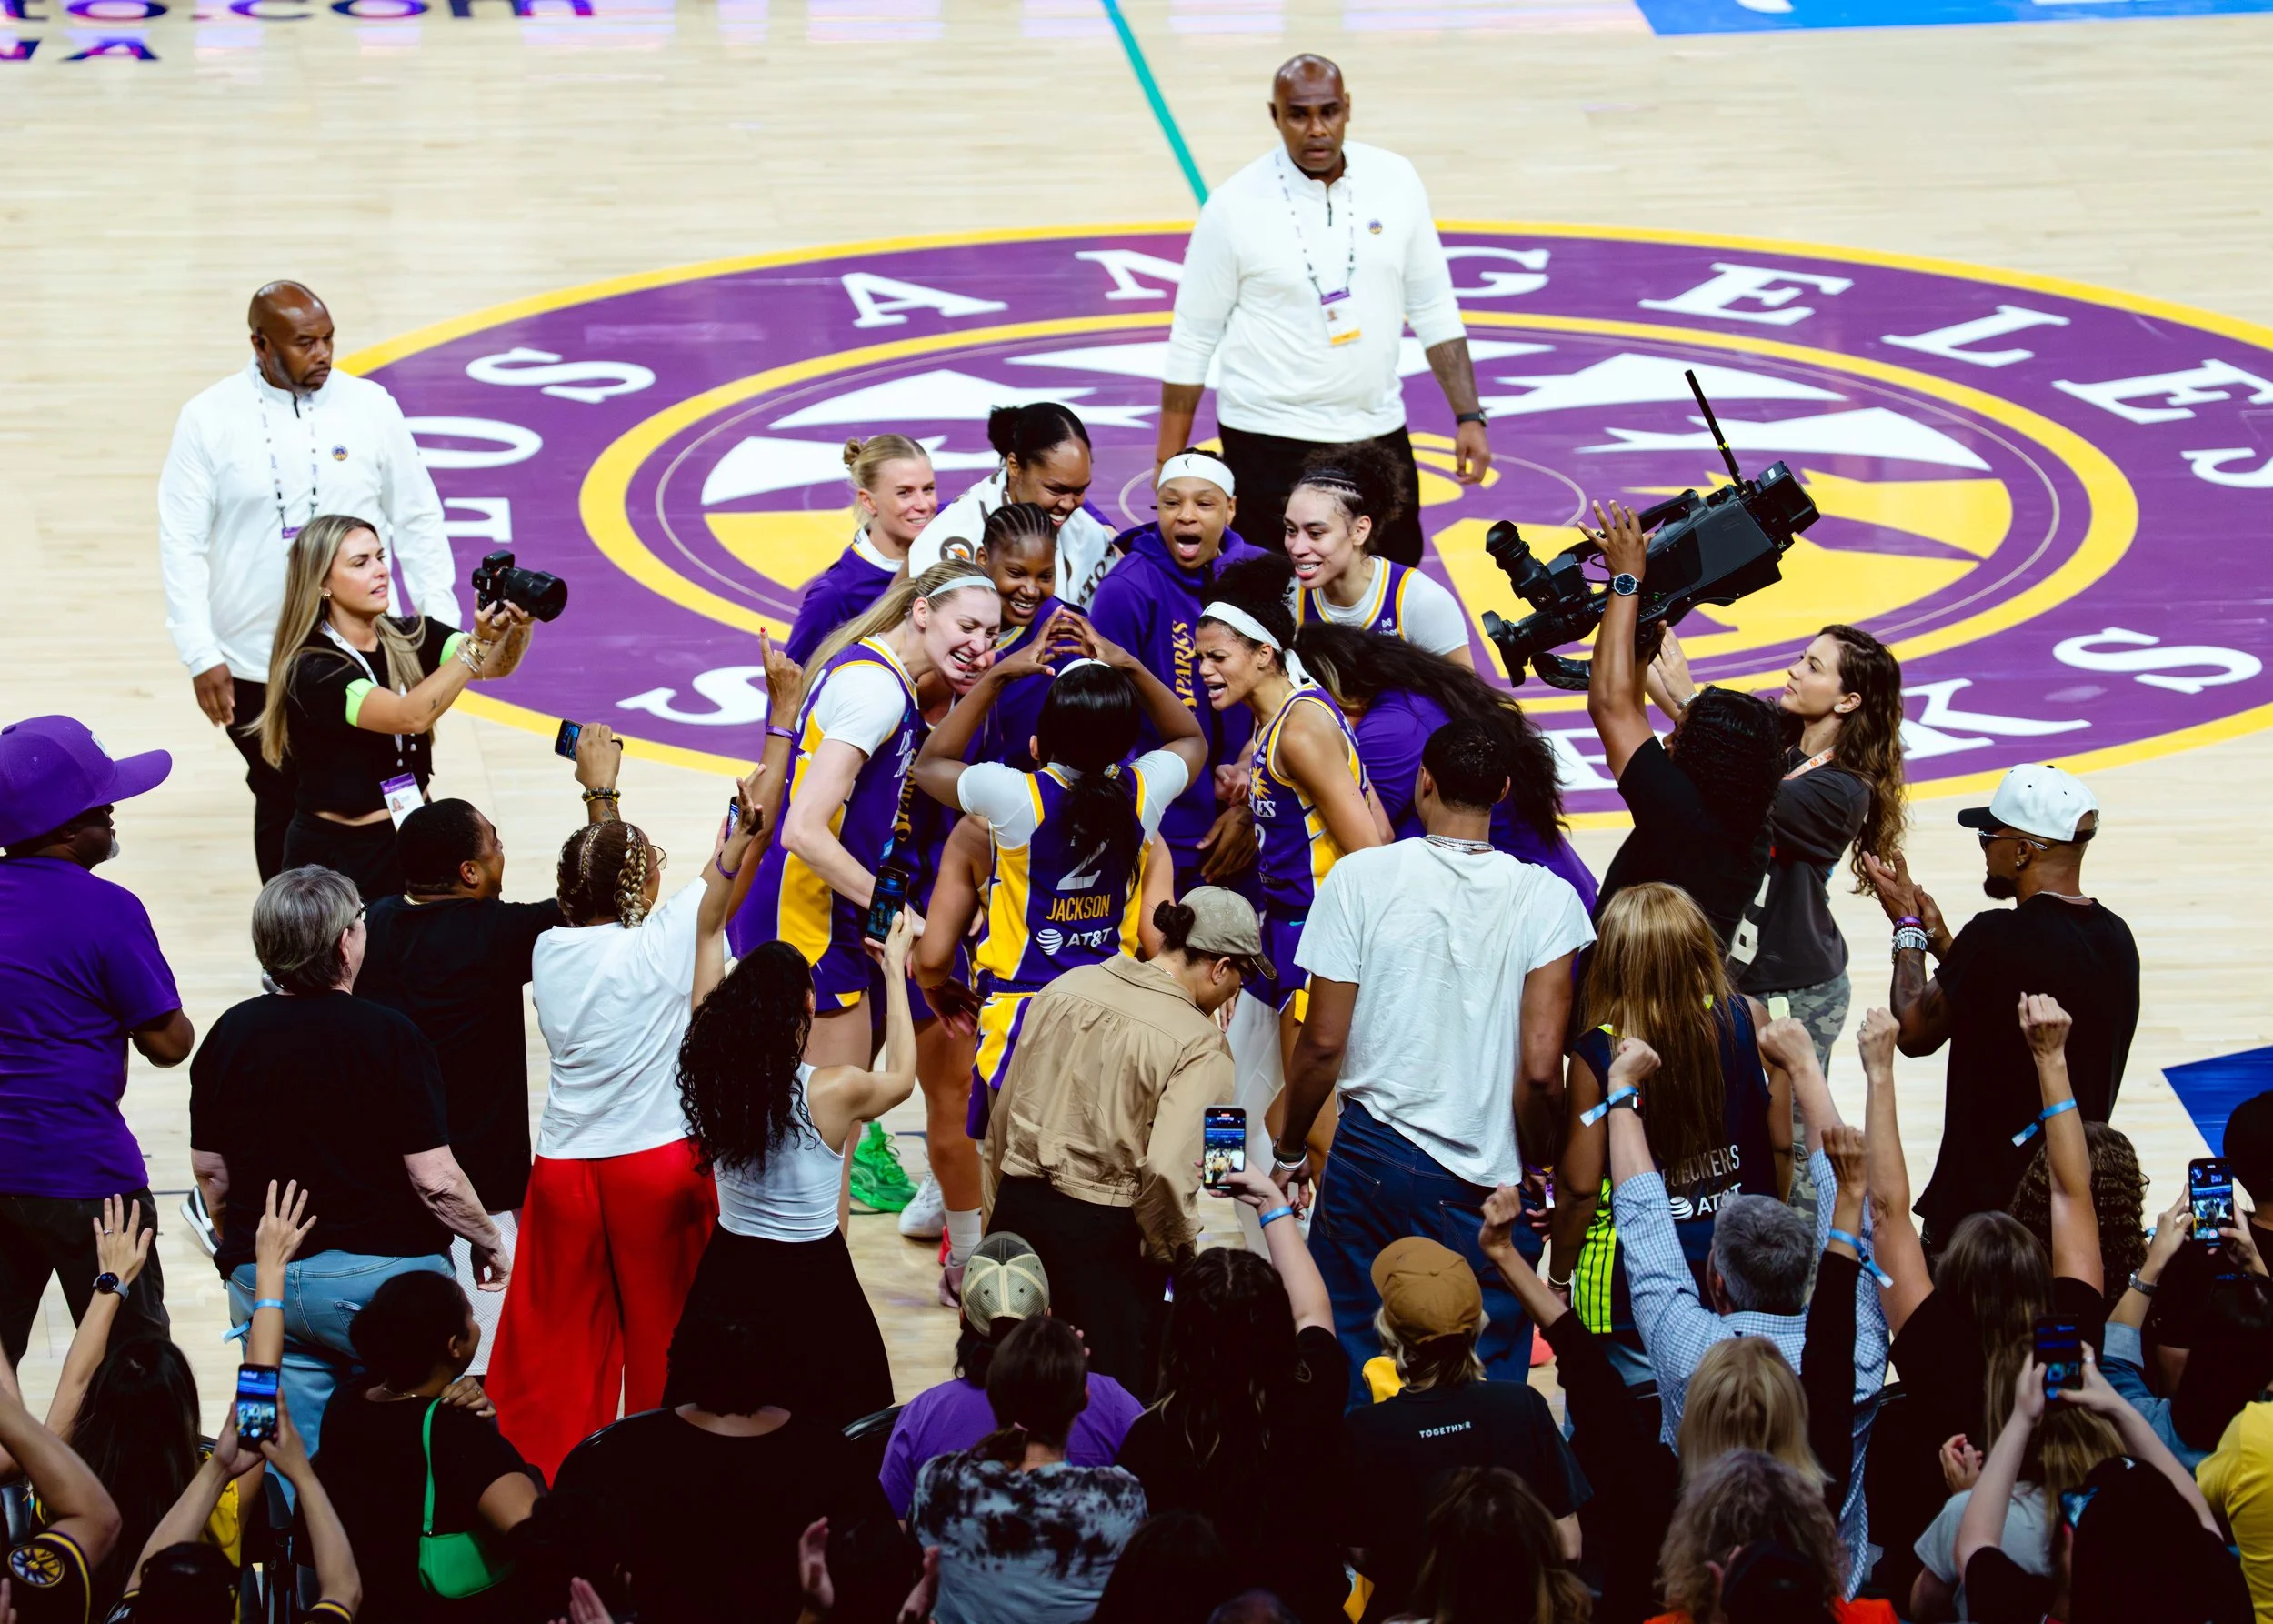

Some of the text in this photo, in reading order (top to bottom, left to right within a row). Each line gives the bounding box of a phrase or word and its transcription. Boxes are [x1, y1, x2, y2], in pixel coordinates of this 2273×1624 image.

[1056, 826, 1106, 890] 2
[1046, 895, 1111, 922] JACKSON
[1066, 927, 1113, 948] AT&T
